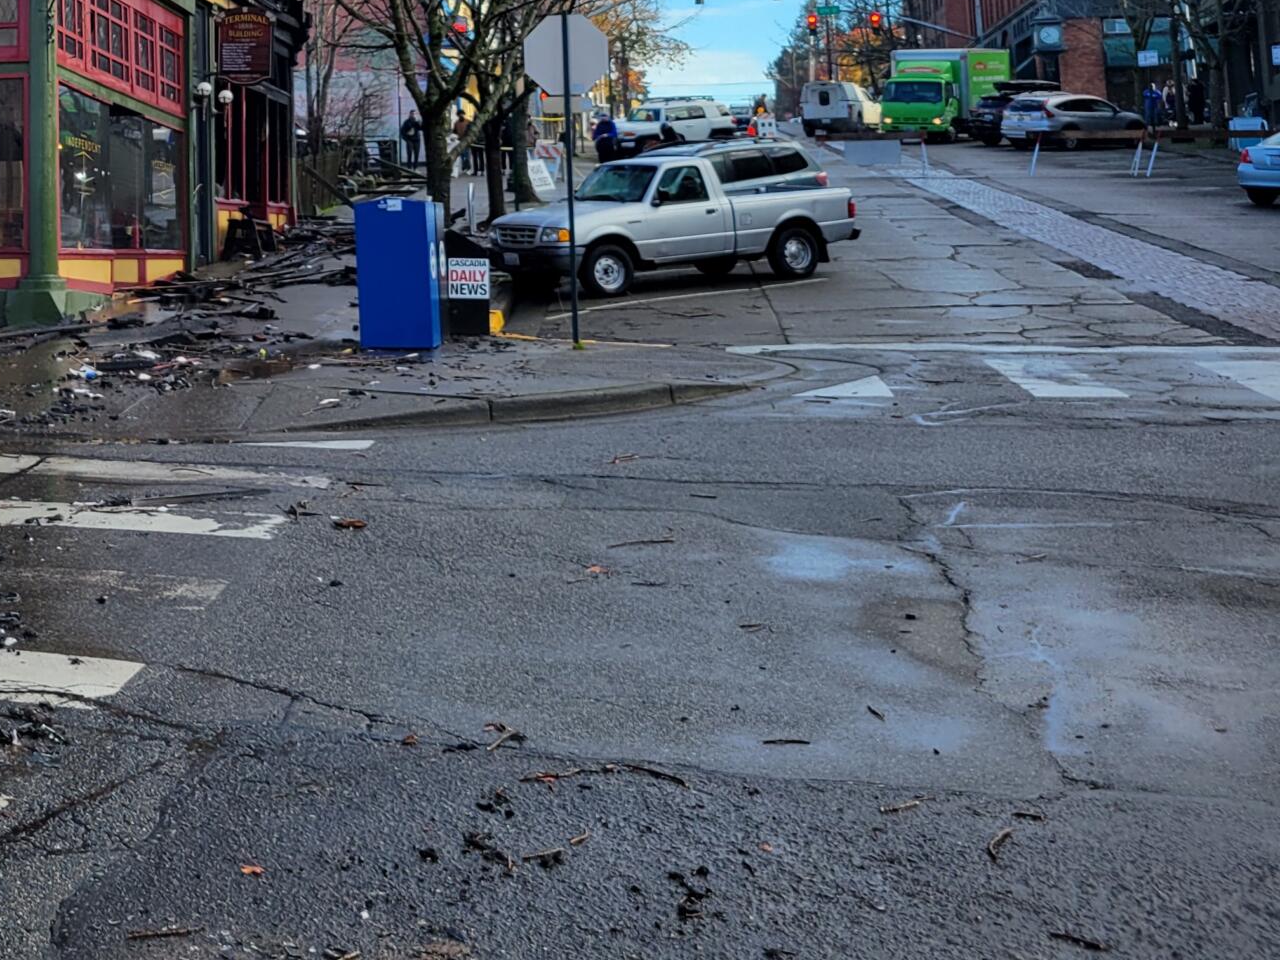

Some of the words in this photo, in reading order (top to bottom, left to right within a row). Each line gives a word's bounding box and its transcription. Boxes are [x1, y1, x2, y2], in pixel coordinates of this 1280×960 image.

[224, 13, 269, 25] TERMINAL
[228, 28, 264, 38] BUILDING
[450, 259, 487, 267] CASCADIA
[450, 269, 486, 282] DAILY
[450, 283, 487, 295] NEWS
